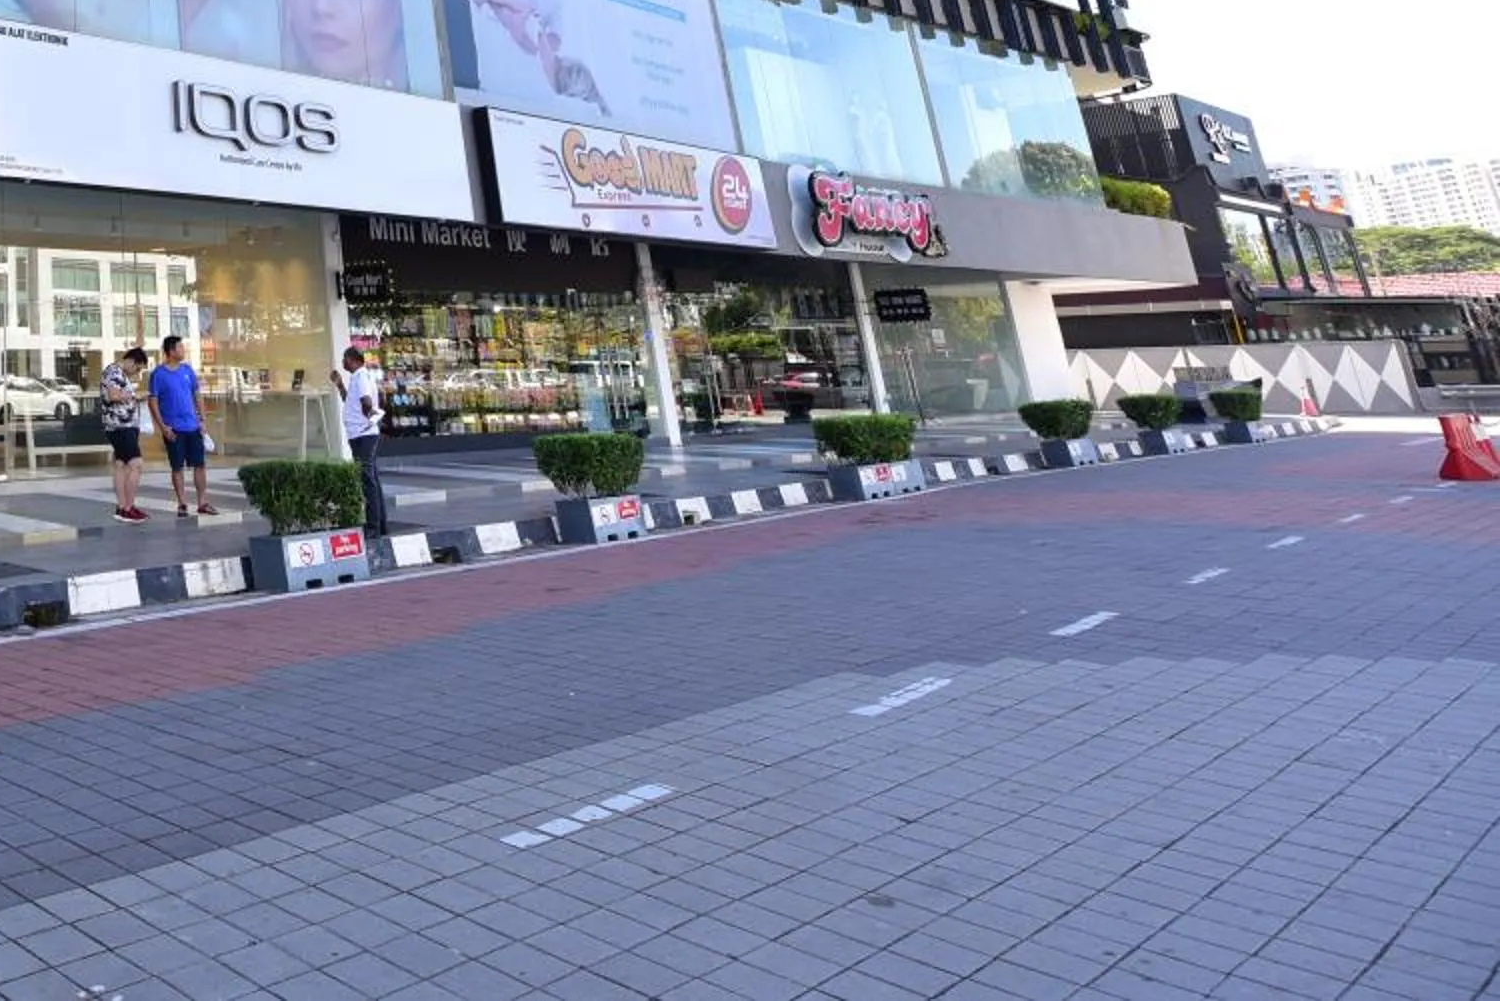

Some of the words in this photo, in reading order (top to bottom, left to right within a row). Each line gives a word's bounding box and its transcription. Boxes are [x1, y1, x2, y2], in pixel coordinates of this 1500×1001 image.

[171, 79, 341, 154] IQOS
[721, 173, 749, 199] 24
[810, 173, 931, 250] Fancy
[368, 216, 415, 244] Mini
[421, 223, 492, 249] Market
